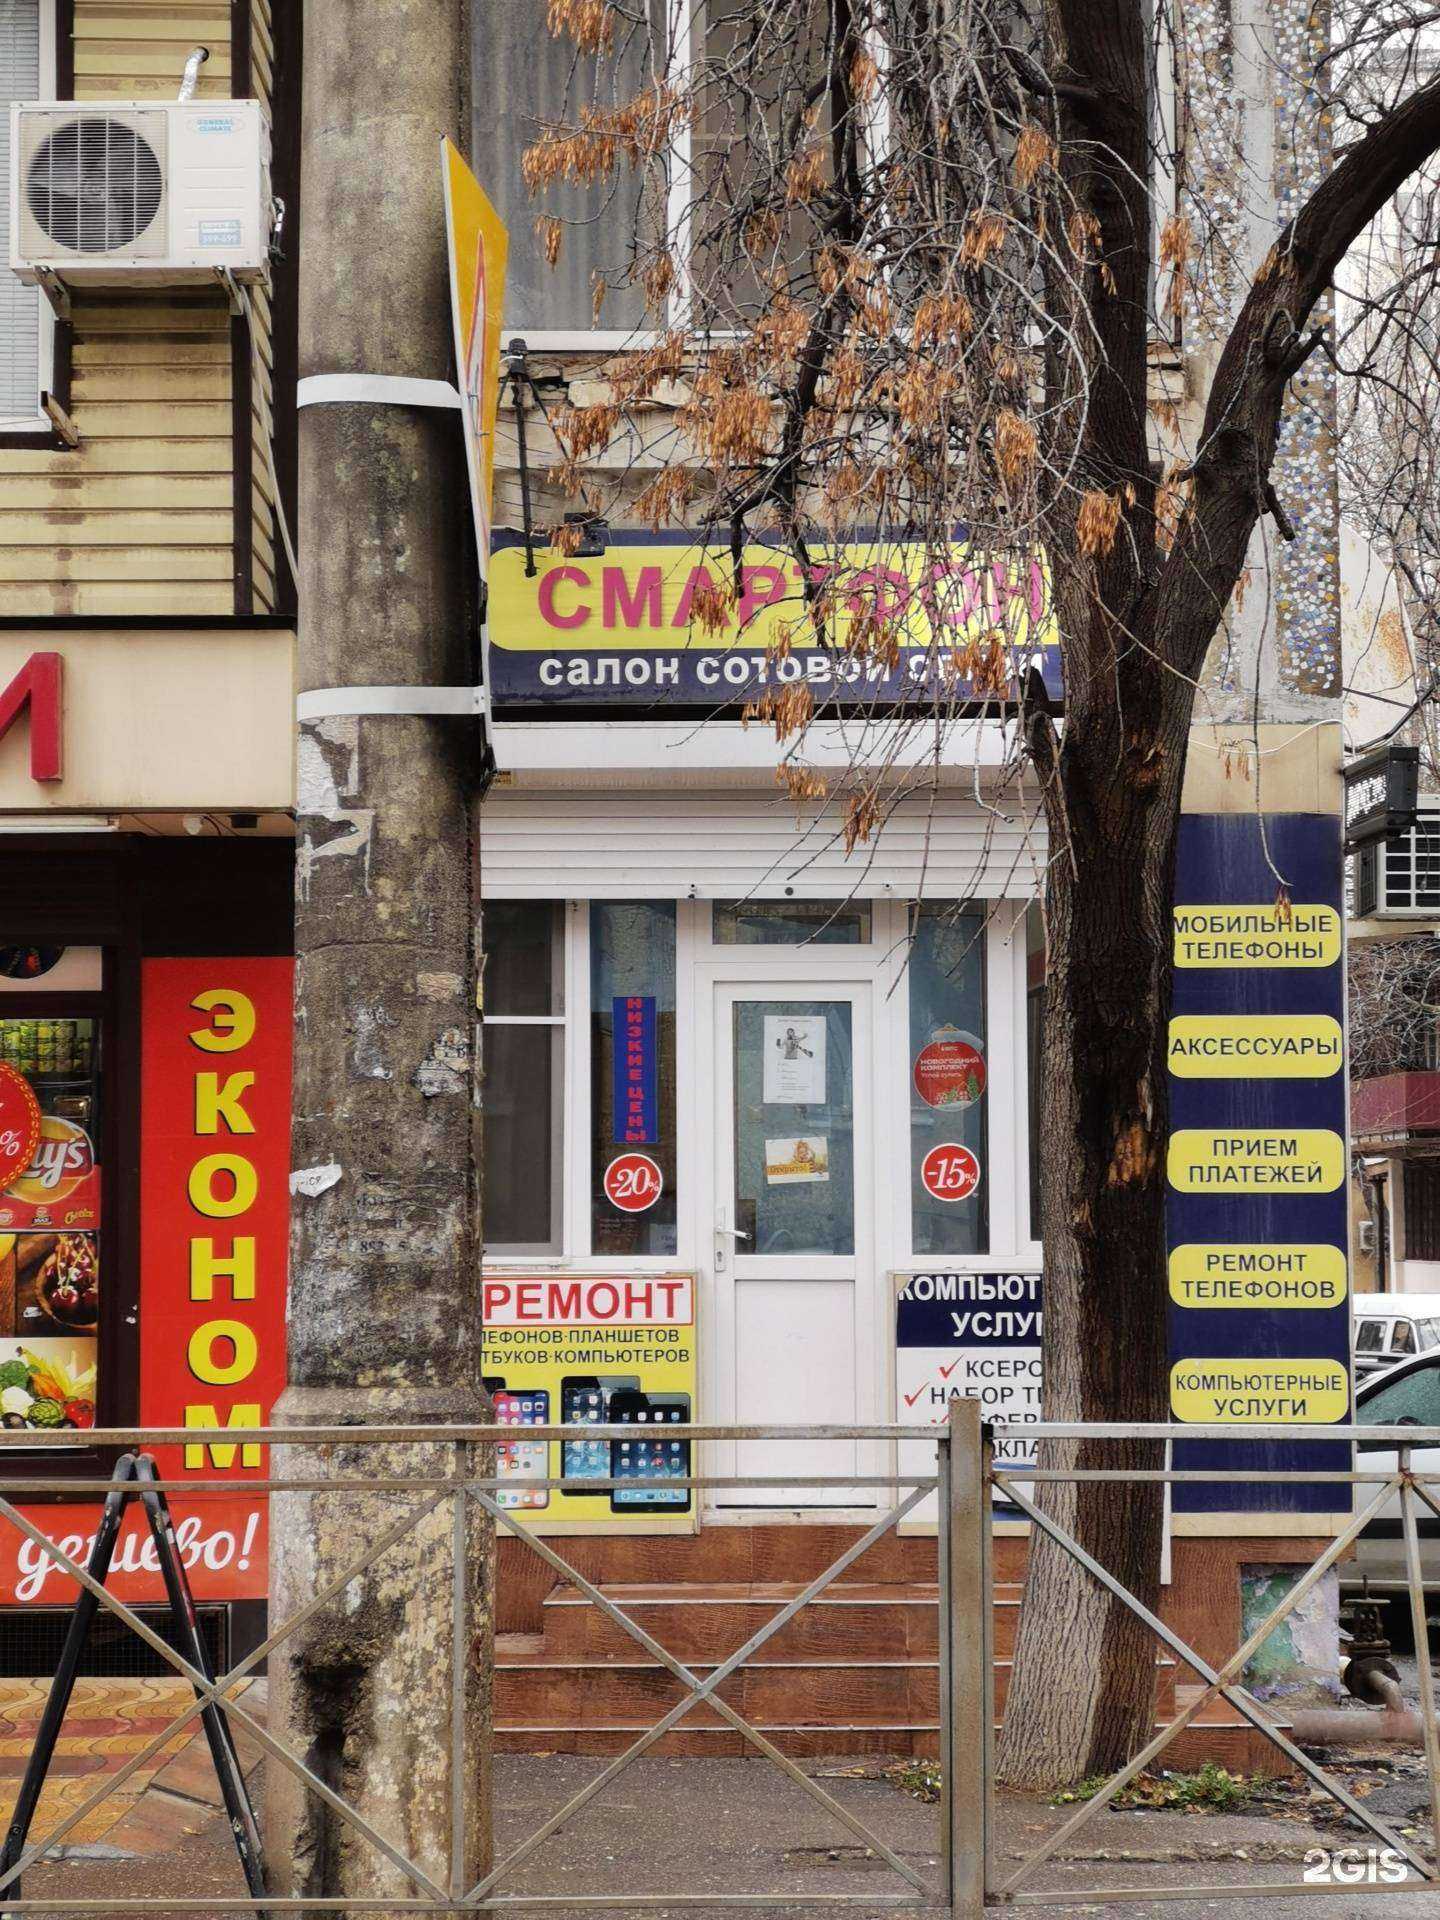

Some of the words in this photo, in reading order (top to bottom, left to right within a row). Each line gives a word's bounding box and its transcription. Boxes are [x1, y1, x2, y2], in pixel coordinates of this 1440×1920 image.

[539, 657, 679, 685] салон
[1174, 915, 1332, 933] МОБИЛЬНЫЕ
[1182, 941, 1323, 959] ТЕЛЕФОНЫ
[1170, 1037, 1338, 1056] АКСЕССУАРЫ
[625, 1086, 646, 1142] ЦЕНЫ
[1213, 1139, 1297, 1156] ПРИЕМ
[927, 1158, 976, 1189] -15%
[1189, 1161, 1323, 1183] ПЛАТЕЖЕЙ
[610, 1166, 660, 1198] -20%
[184, 988, 261, 1469] ЭКОНОМ
[1206, 1254, 1307, 1272] РЕМОНТ
[1181, 1280, 1335, 1298] ТЕЛЕФОНОВ
[484, 1282, 684, 1320] РЕМОНТ
[1175, 1374, 1343, 1391] КОМПЬЮТЕРНЫЕ
[1214, 1399, 1307, 1416] УСЛУГИ
